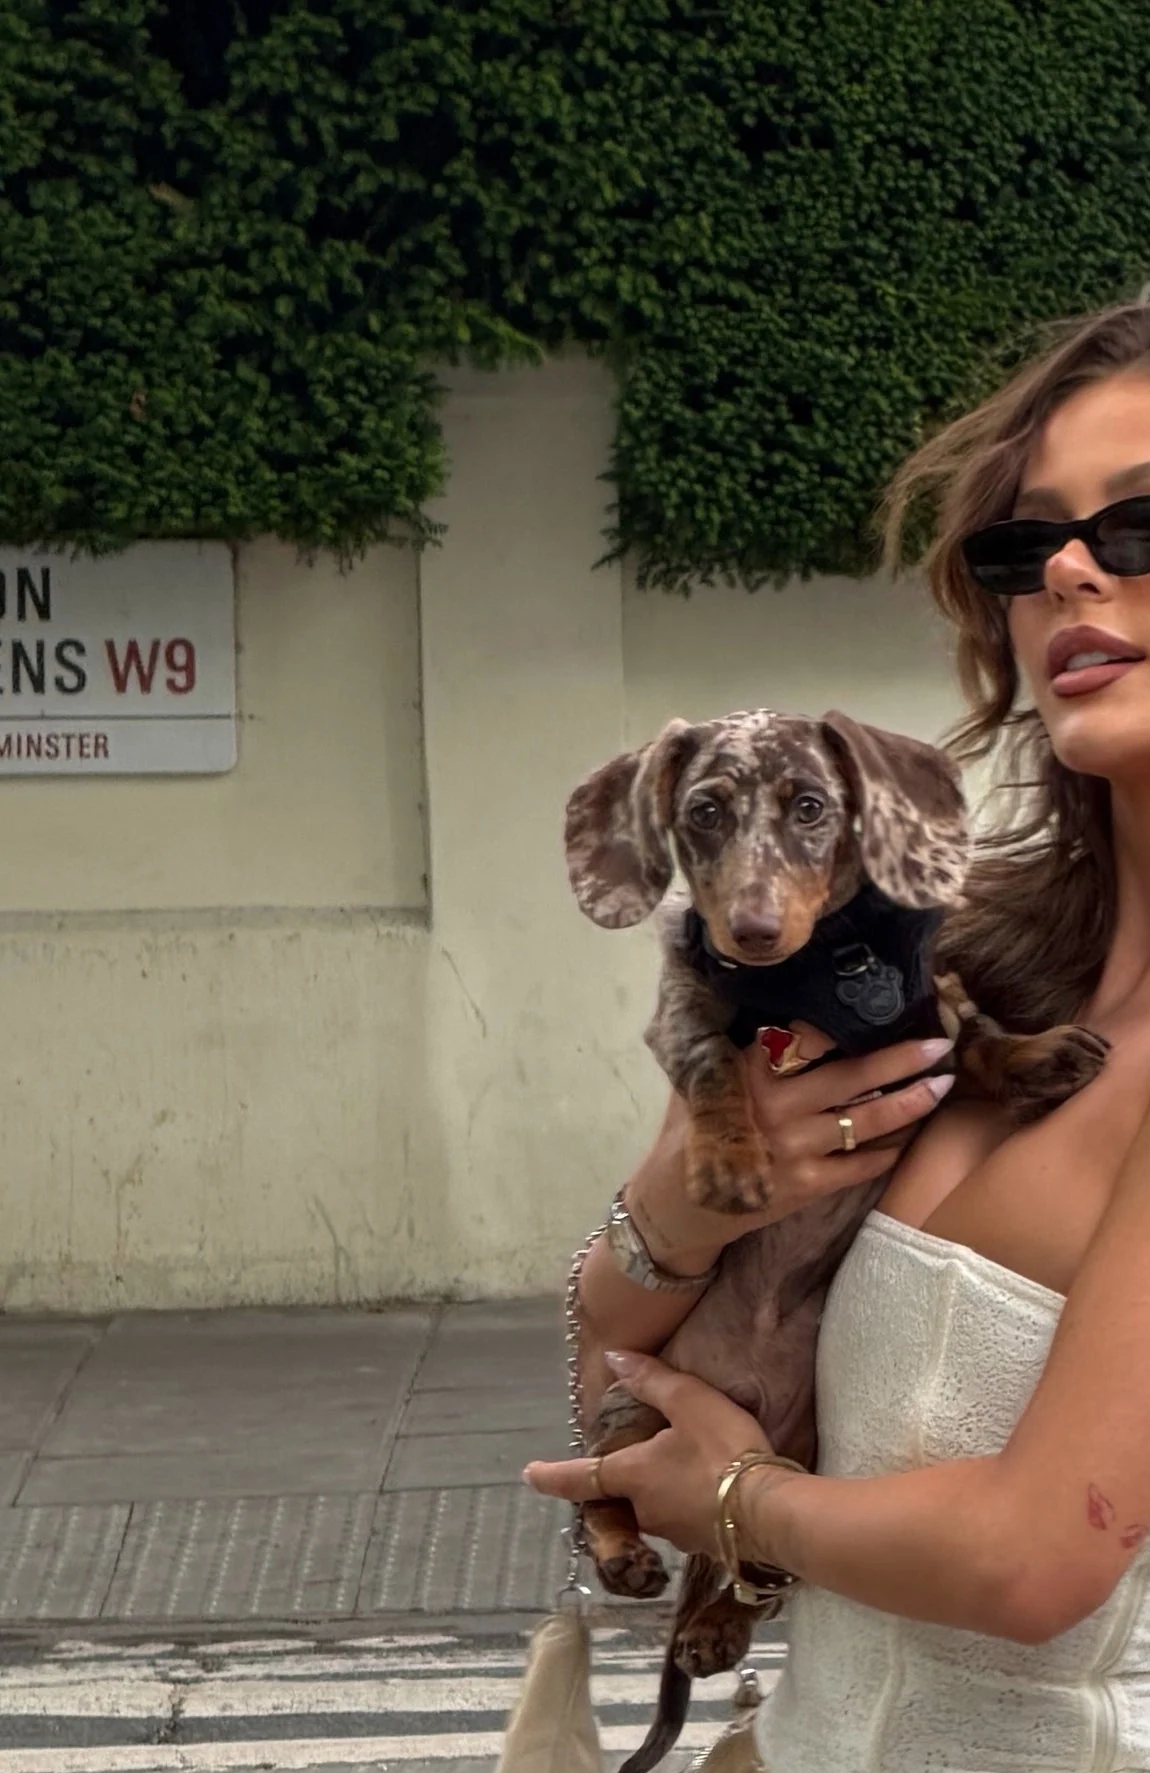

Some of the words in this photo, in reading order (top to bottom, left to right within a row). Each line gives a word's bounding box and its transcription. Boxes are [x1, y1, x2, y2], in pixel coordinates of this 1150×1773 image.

[0, 567, 51, 622] N
[0, 638, 87, 695] NS
[104, 637, 196, 695] W9
